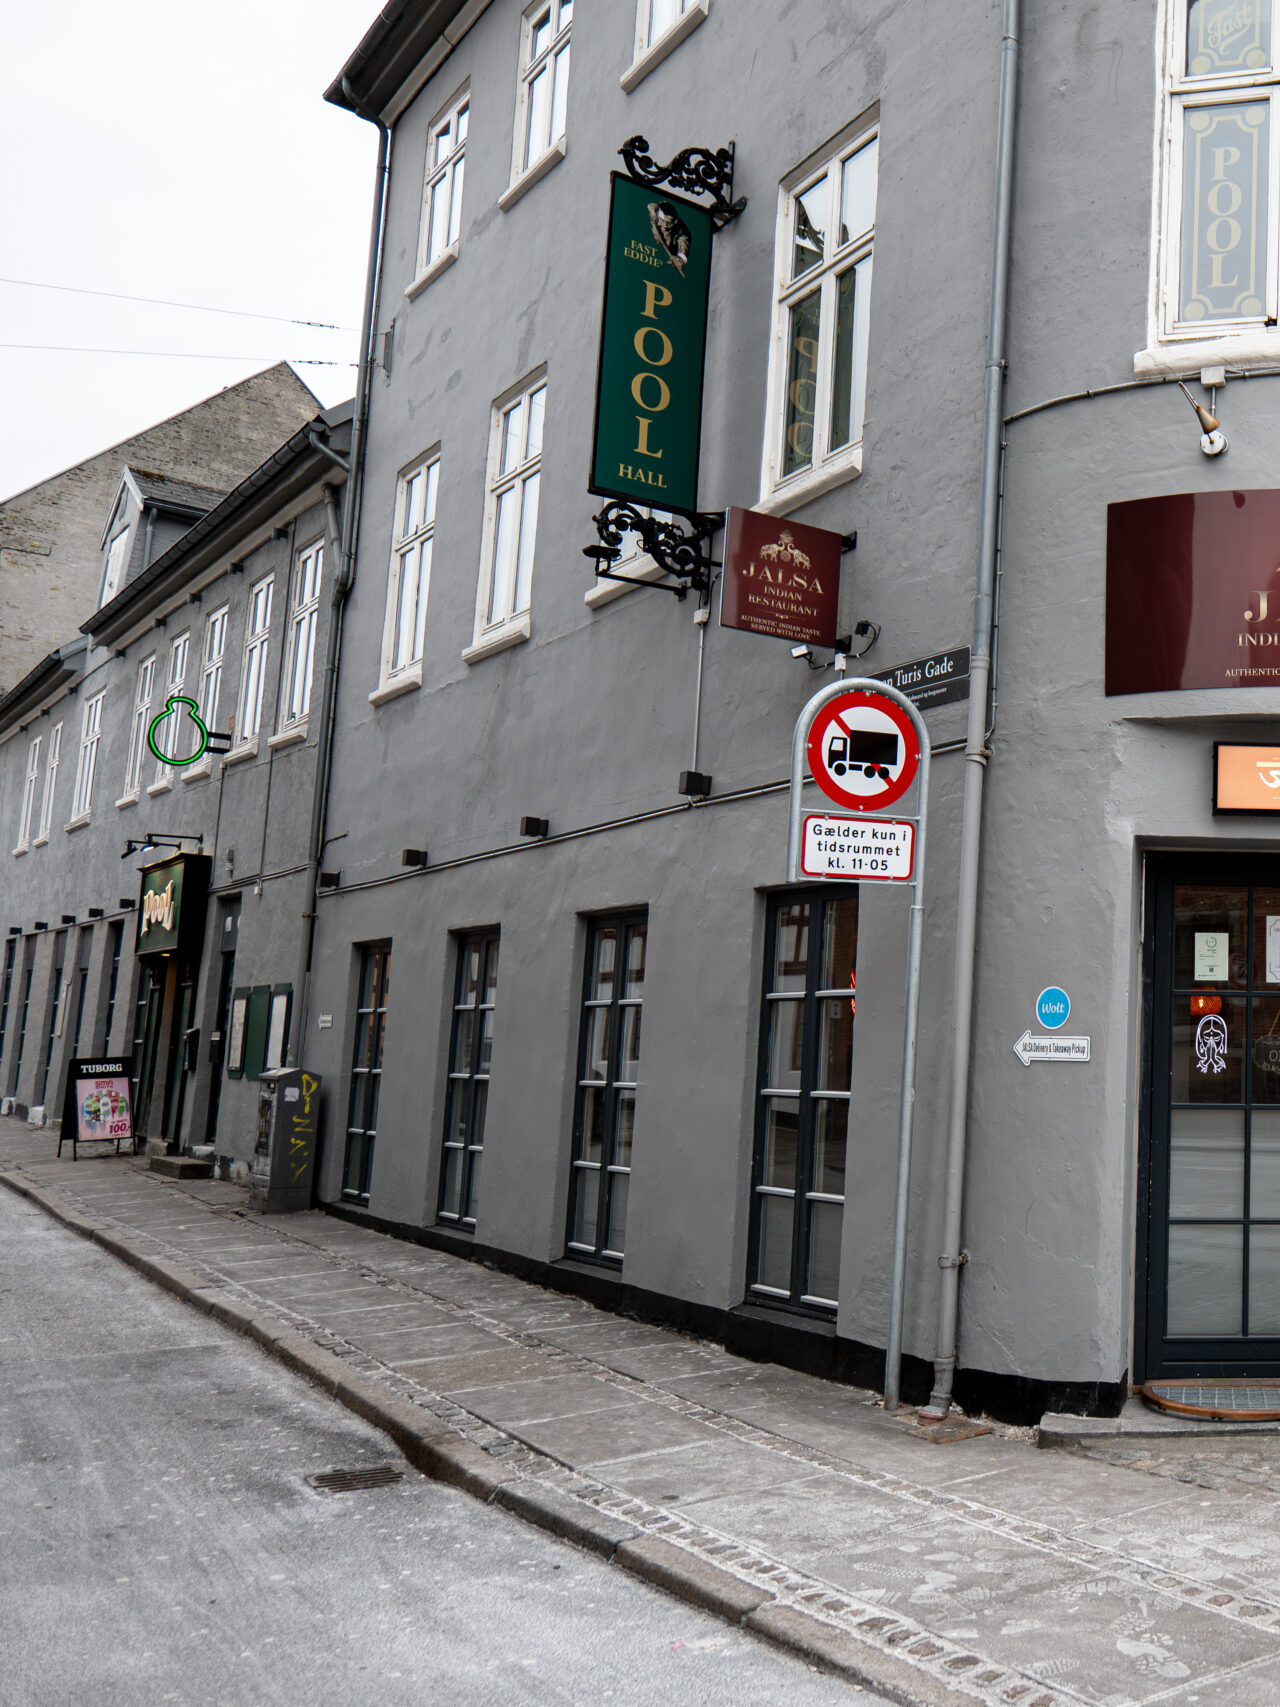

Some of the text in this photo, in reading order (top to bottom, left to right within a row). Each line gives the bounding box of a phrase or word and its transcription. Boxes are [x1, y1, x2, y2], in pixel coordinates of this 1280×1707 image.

[1207, 146, 1242, 288] POOL
[631, 240, 658, 256] FAST
[631, 280, 673, 458] POOL
[619, 463, 667, 488] HALL
[742, 561, 824, 594] JALSA
[764, 585, 802, 601] INDIAN
[748, 593, 819, 616] RESTAURANT
[741, 614, 820, 636] AUTHENTIC INDIAN TASTE
[751, 623, 811, 640] SERVED WITH LOVE
[895, 665, 922, 687] Turis
[925, 656, 954, 678] Gade
[813, 824, 907, 841] Gælder kun i
[817, 840, 900, 856] tidsrummet
[828, 857, 845, 868] kl.
[1041, 1002, 1064, 1014] Wolt
[1052, 1042, 1071, 1056] Takeaway
[1071, 1043, 1086, 1056] Pickup
[81, 1064, 123, 1073] TUBORG
